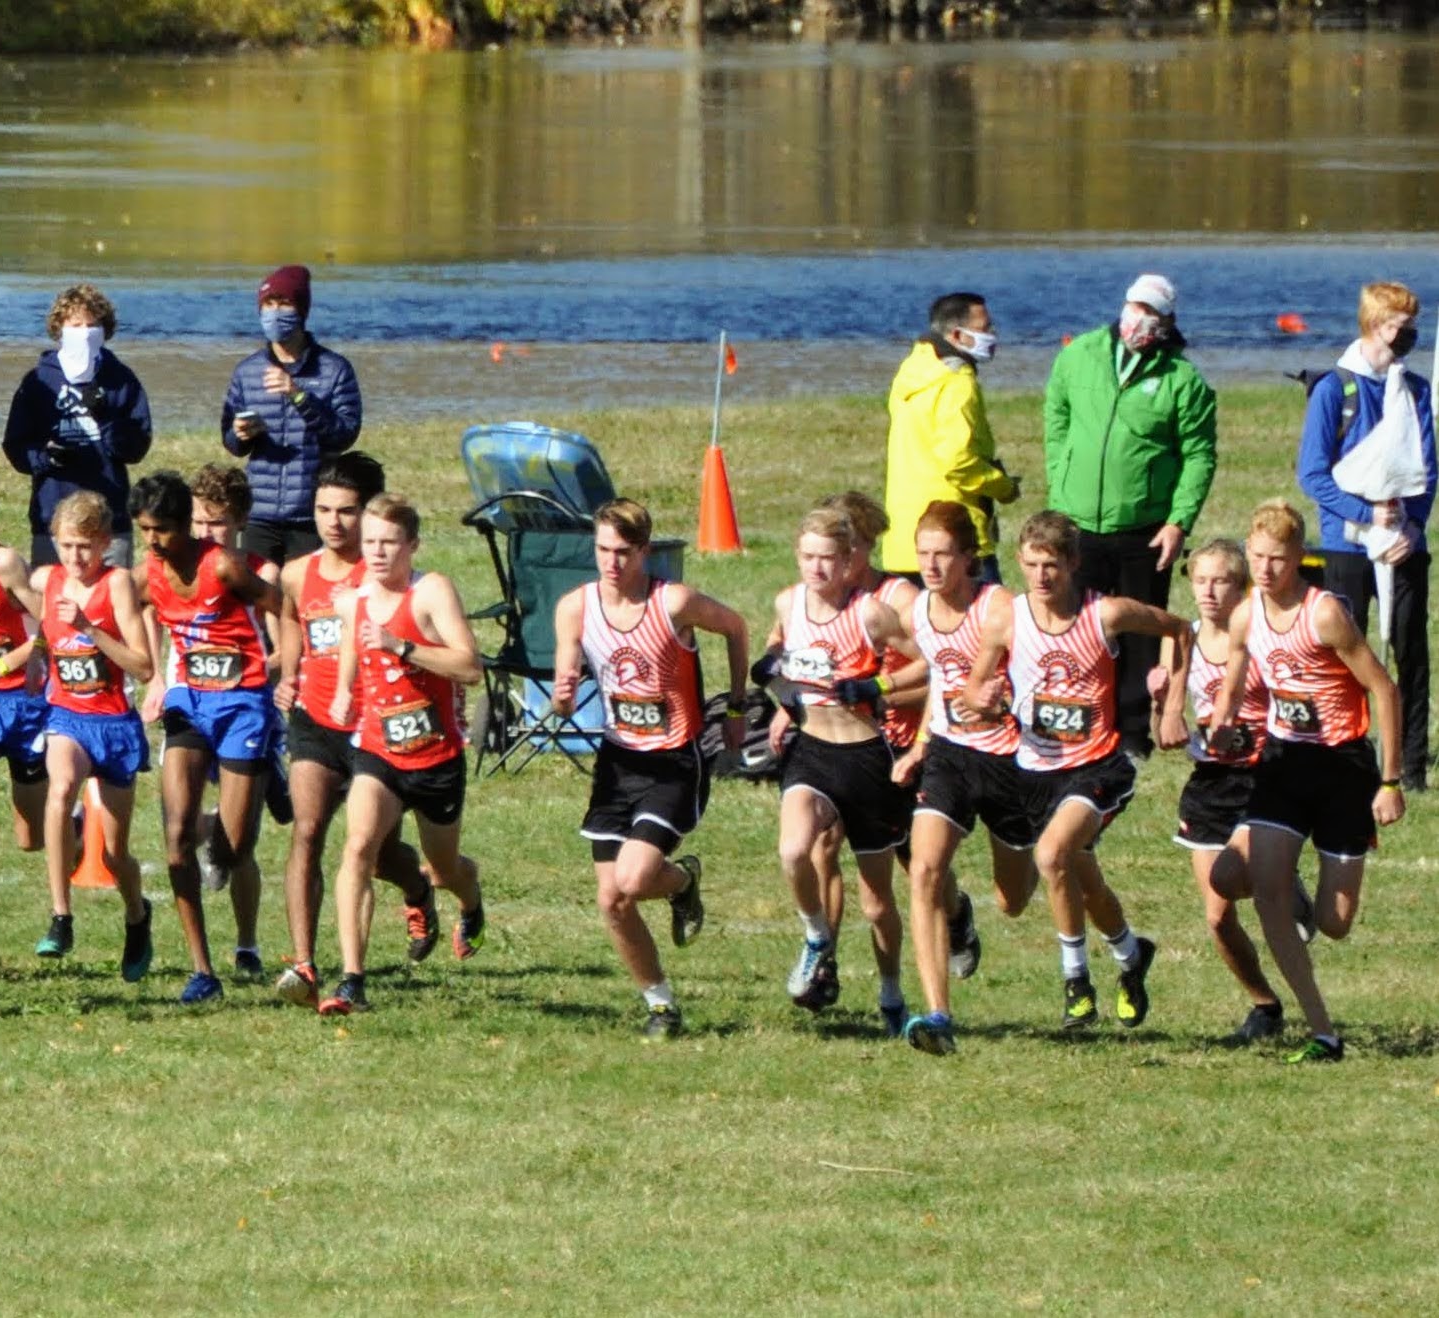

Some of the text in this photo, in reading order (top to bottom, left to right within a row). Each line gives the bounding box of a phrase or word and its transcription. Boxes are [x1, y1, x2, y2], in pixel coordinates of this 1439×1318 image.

[57, 658, 99, 681] 361
[189, 655, 234, 677] 367
[618, 702, 661, 725] 626
[1038, 704, 1085, 731] 624
[388, 711, 432, 742] 521
